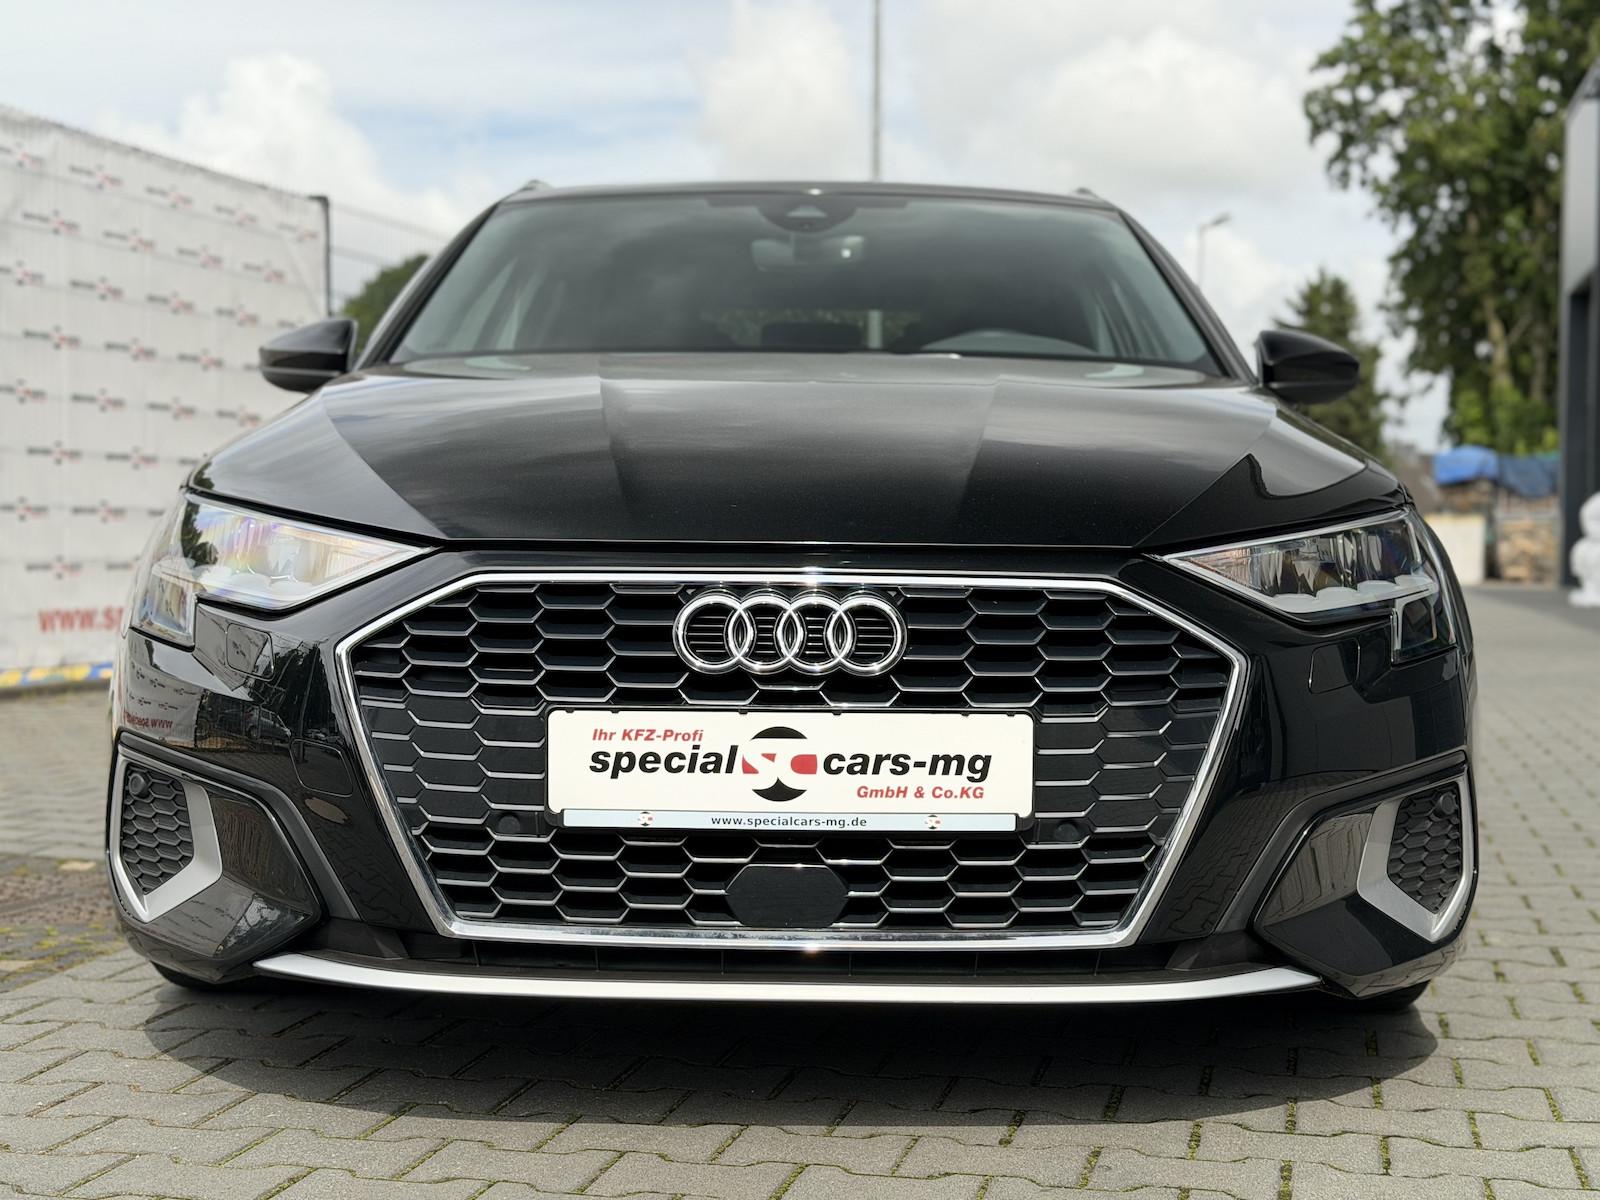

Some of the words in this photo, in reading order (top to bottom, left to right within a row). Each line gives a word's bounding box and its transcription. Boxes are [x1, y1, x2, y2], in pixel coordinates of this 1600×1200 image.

[592, 728, 617, 742] Ihr
[621, 729, 704, 743] KFZ-Profi
[589, 744, 739, 780] special
[823, 753, 992, 784] cars-mg
[856, 785, 908, 799] GmbH
[914, 785, 925, 799] &
[931, 786, 985, 799] Co.KG
[711, 815, 867, 829] www.specialcars-mg.de
